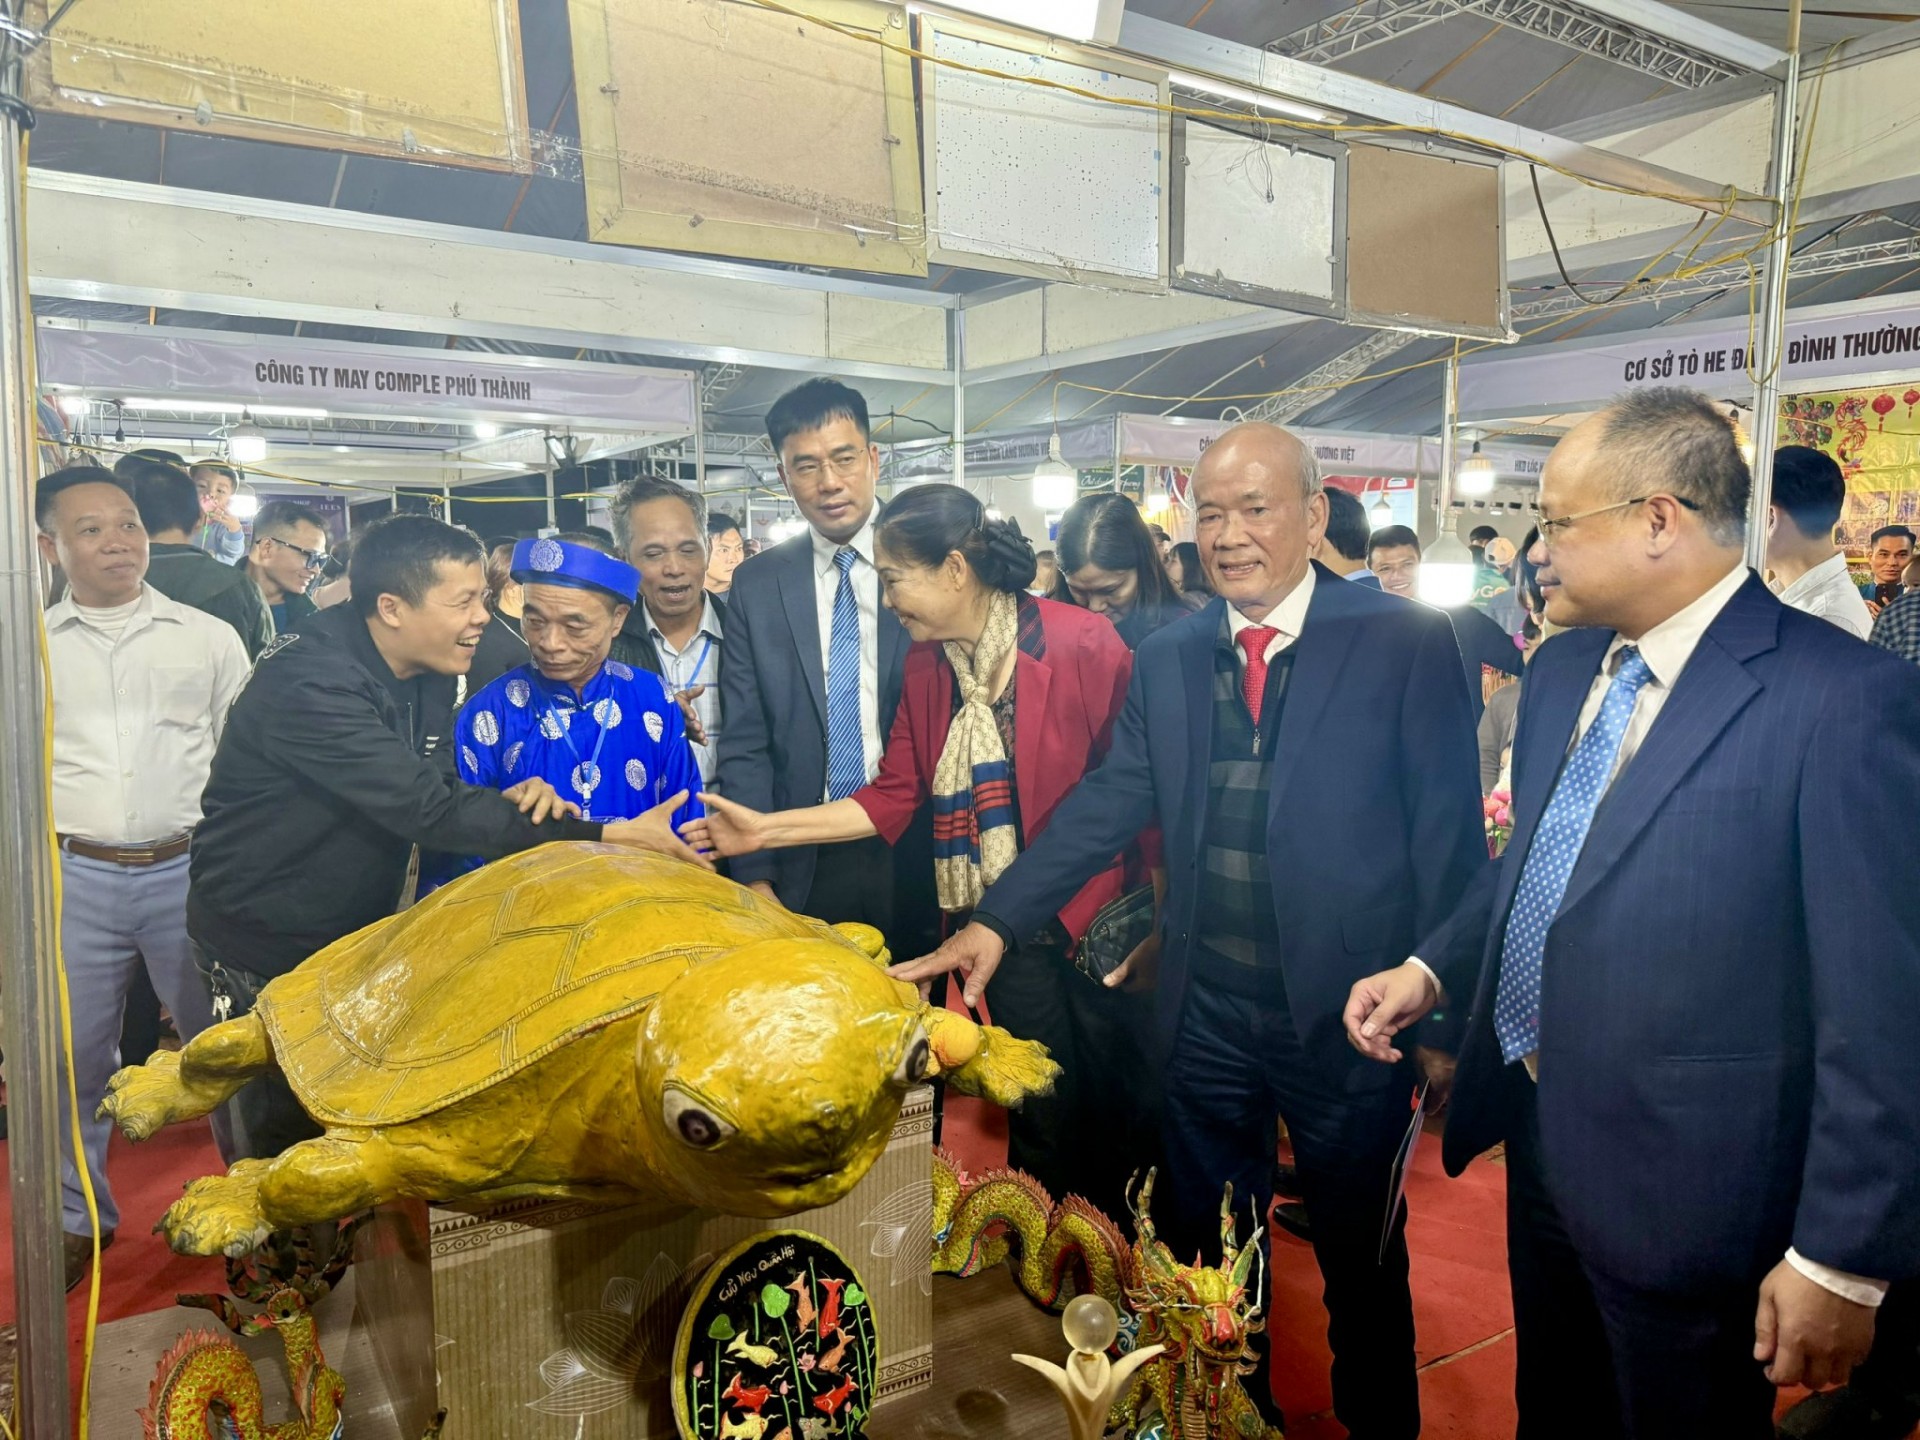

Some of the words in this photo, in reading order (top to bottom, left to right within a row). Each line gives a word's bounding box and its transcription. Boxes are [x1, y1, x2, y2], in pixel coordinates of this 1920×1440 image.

[1624, 357, 1648, 382] CƠ
[1650, 349, 1674, 379] SỞ
[1677, 348, 1699, 376] TÒ
[1703, 350, 1726, 373] HE
[1788, 334, 1836, 364] ĐÌNH
[1842, 323, 1920, 358] THƯỜNG
[255, 359, 304, 386] CÔNG
[308, 366, 328, 387] TY
[334, 367, 369, 389] MAY
[374, 371, 440, 395] COMPLE
[445, 374, 477, 397] PHÚ
[480, 376, 531, 400] THÀNH
